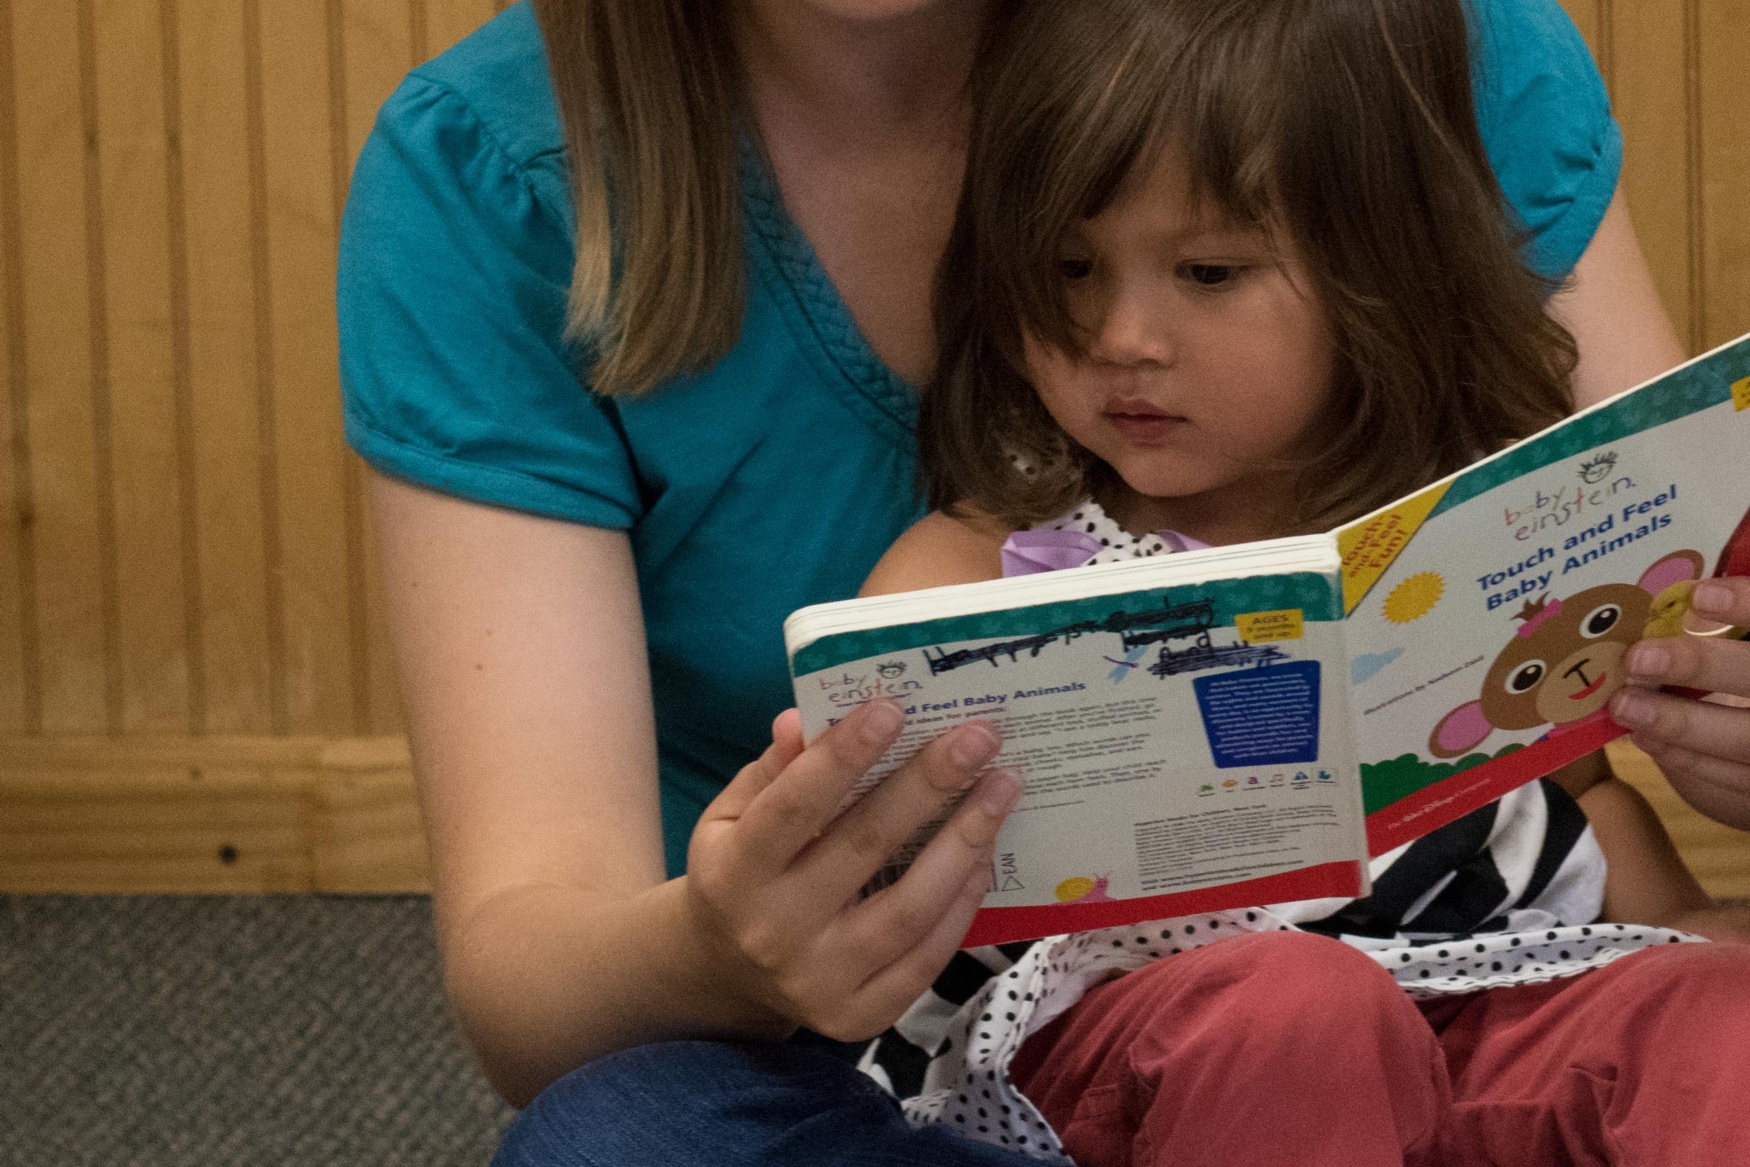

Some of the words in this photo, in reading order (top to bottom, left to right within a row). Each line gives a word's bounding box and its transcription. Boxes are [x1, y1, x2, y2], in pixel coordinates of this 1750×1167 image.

[1503, 486, 1566, 526] baby
[1514, 476, 1633, 541] einstein
[1476, 546, 1555, 591] Touch
[1562, 513, 1615, 551] and
[1622, 484, 1677, 523] Feel
[1486, 569, 1553, 611] Baby
[1561, 513, 1673, 575] Animals
[1252, 614, 1289, 625] AGES
[828, 678, 923, 702] einsten
[921, 699, 959, 713] Feel
[963, 693, 1009, 708] Baby
[1013, 682, 1087, 700] Animals
[1001, 852, 1018, 875] EAN
